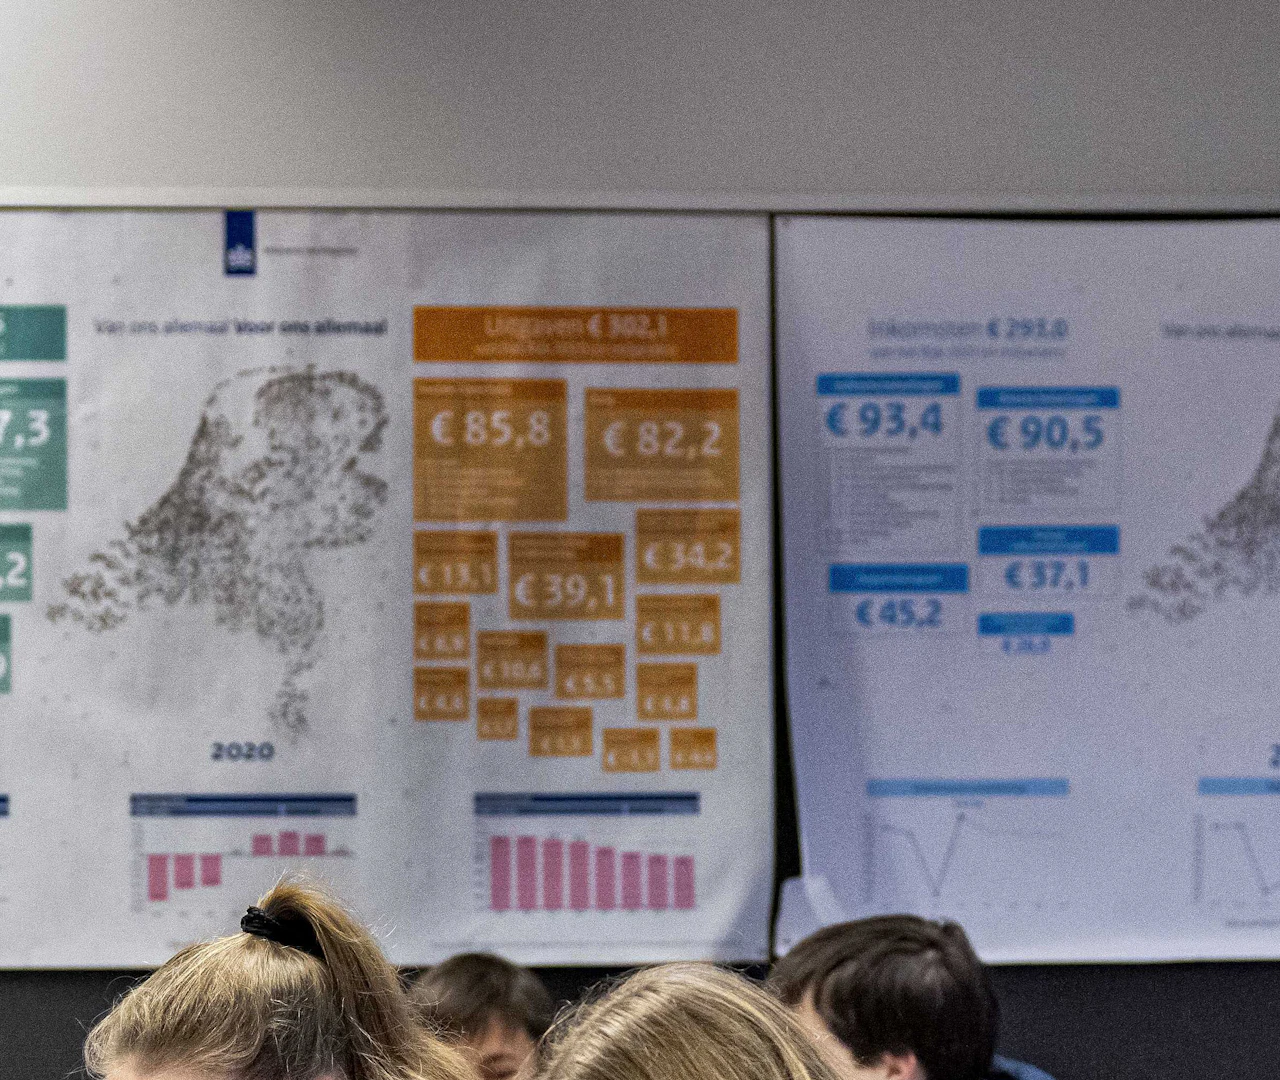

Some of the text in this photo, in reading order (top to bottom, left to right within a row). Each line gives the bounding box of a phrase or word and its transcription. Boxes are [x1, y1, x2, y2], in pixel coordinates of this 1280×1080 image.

[431, 410, 550, 448] € 85,8
[826, 401, 943, 440] € 93,4
[987, 414, 1105, 453] € 90,5
[603, 421, 721, 460] € 82,2
[643, 542, 660, 569] €
[514, 573, 615, 611] € 39,1
[1005, 561, 1021, 589] €
[856, 600, 871, 627] €
[210, 742, 276, 762] 2020
